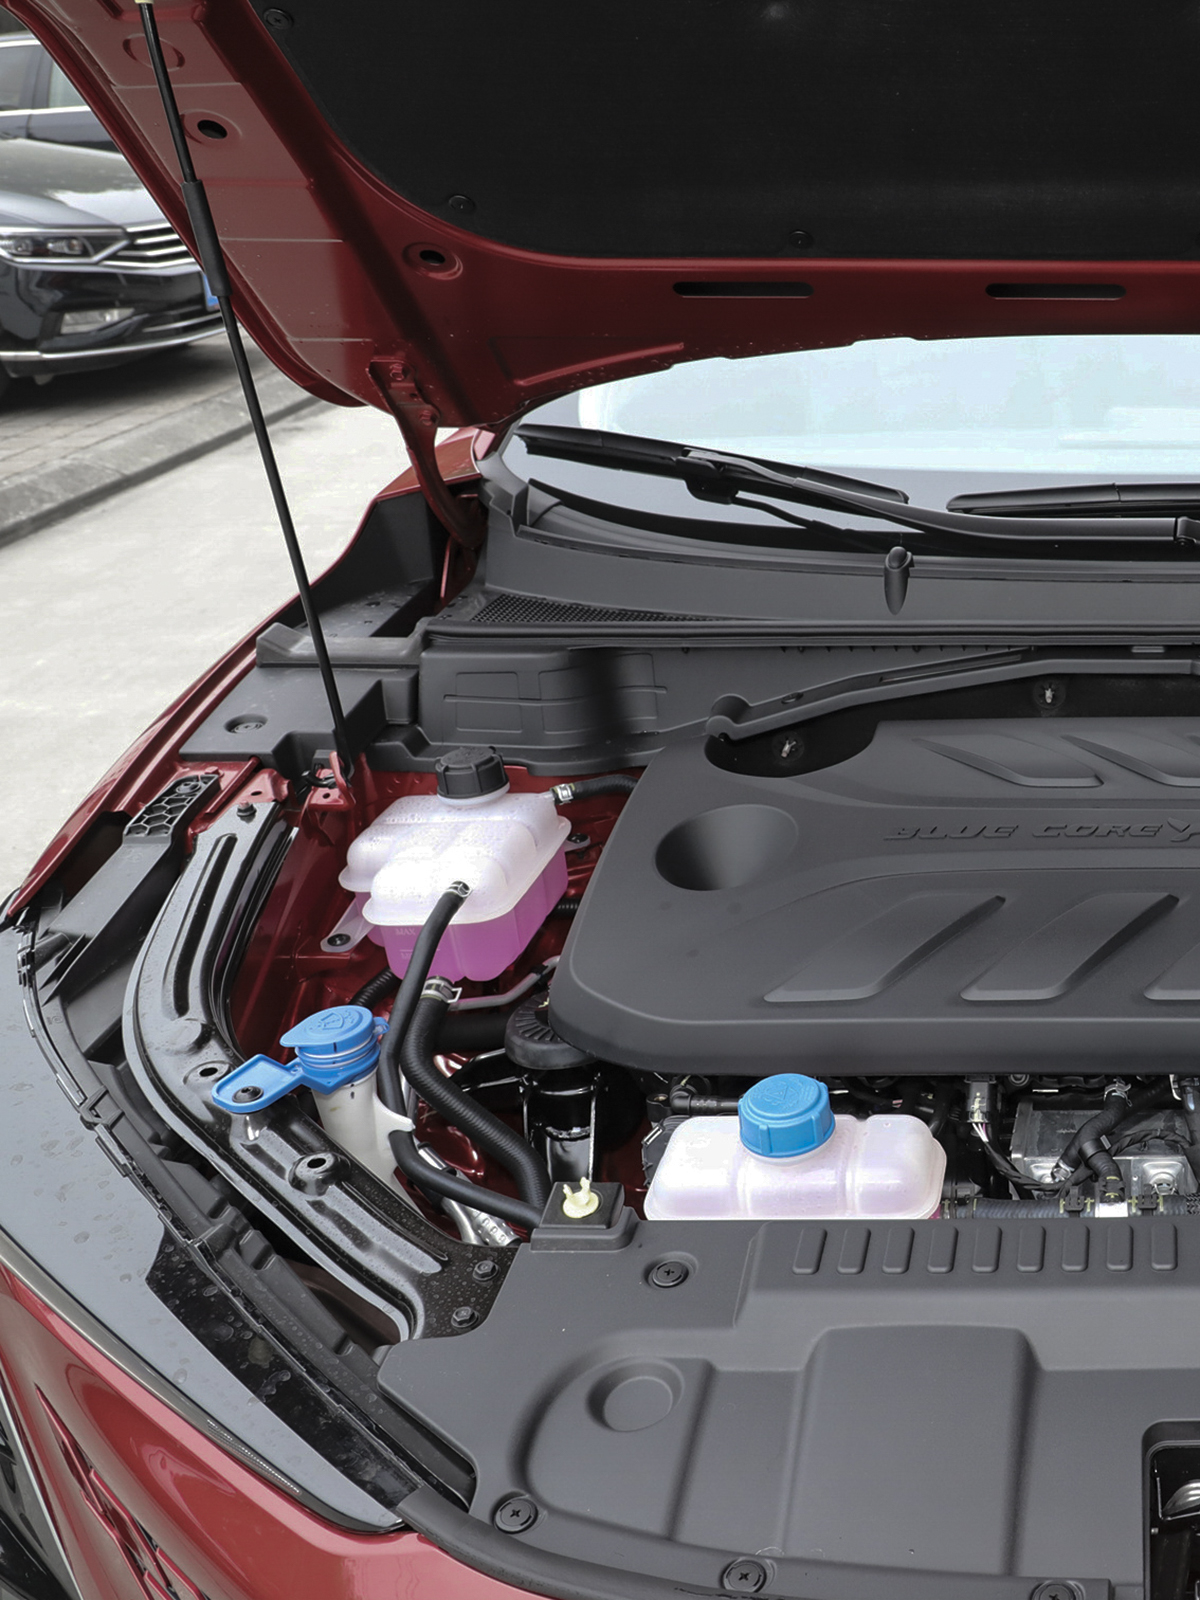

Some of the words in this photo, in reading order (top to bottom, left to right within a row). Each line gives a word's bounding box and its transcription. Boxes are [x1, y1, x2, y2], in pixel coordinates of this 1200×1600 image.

[884, 824, 1019, 841] BLUE
[1032, 823, 1163, 838] CORE
[395, 928, 416, 936] MAX
